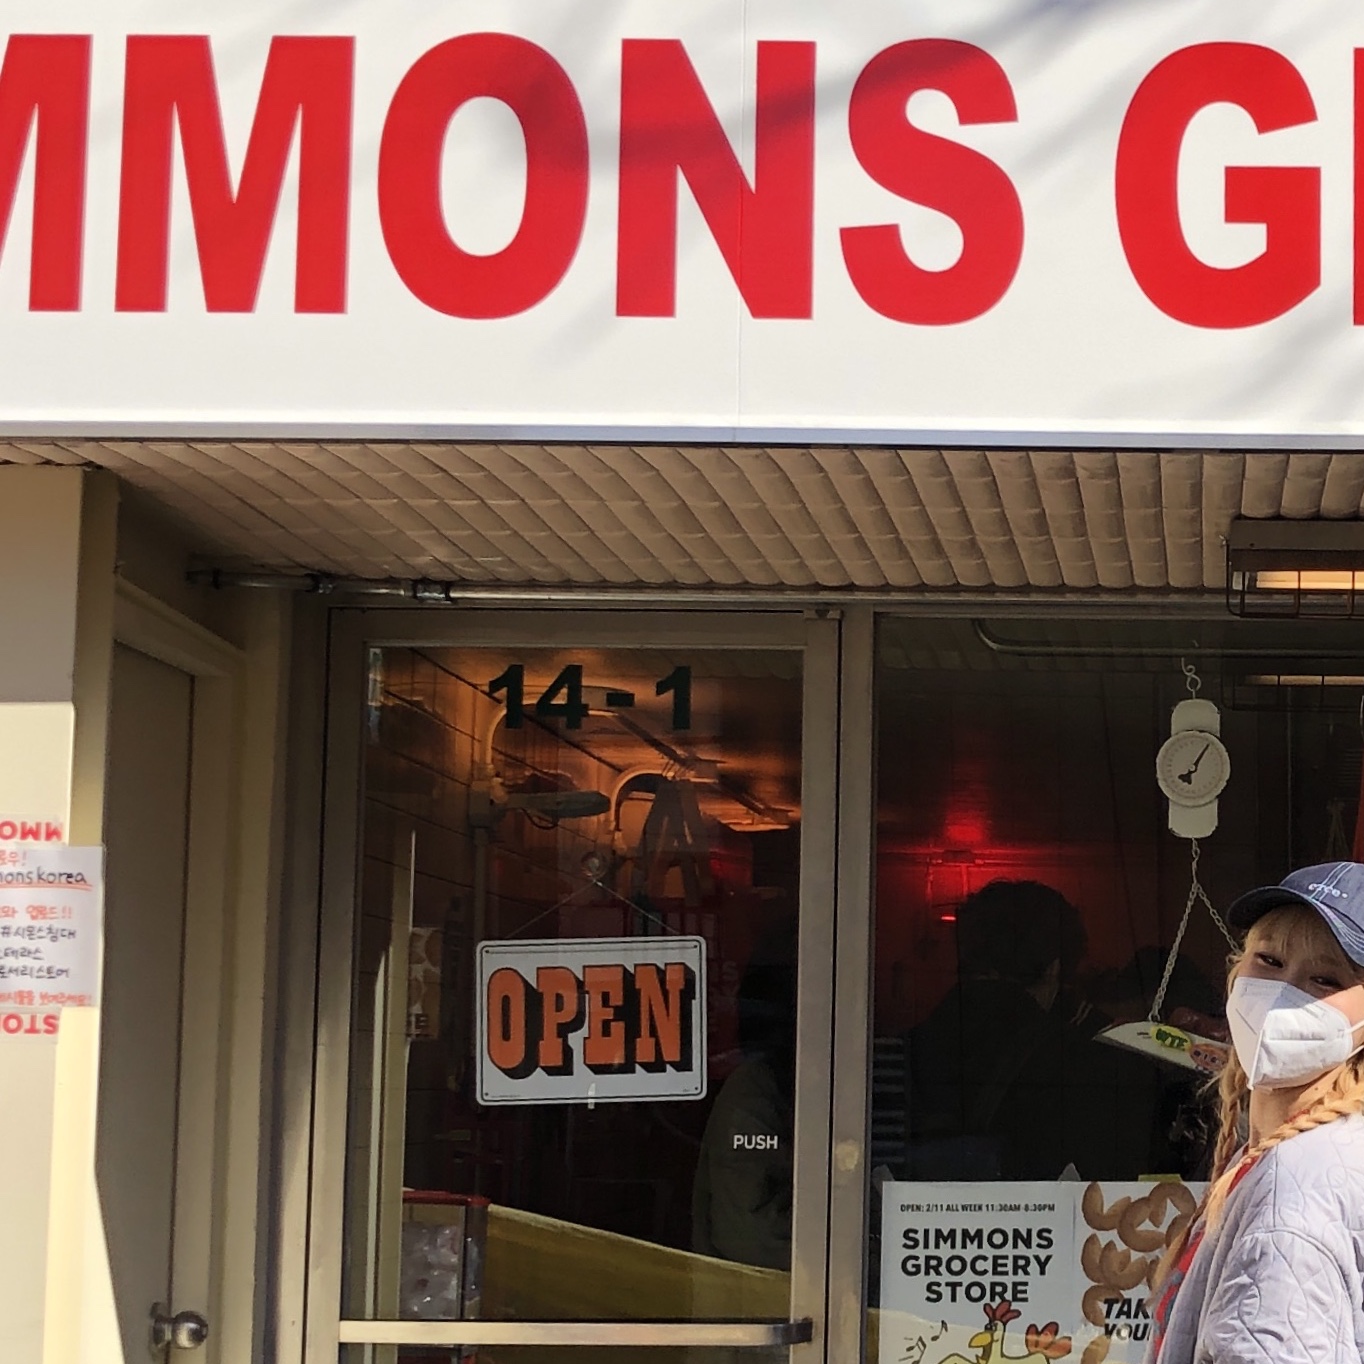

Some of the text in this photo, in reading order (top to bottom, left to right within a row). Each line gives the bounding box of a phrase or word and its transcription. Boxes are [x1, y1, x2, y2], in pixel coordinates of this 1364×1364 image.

[487, 961, 694, 1081] OPEN
[733, 1133, 779, 1151] PUSH
[900, 1203, 925, 1213] OPEN:
[926, 1203, 944, 1213] 2/11
[945, 1203, 960, 1213] ALL
[961, 1203, 983, 1213] WEEK
[901, 1227, 1055, 1251] SIMMONS
[900, 1254, 1054, 1278] GROCERY
[925, 1280, 1030, 1304] STORE
[1103, 1297, 1154, 1320] TAK
[1104, 1323, 1152, 1342] YOU
